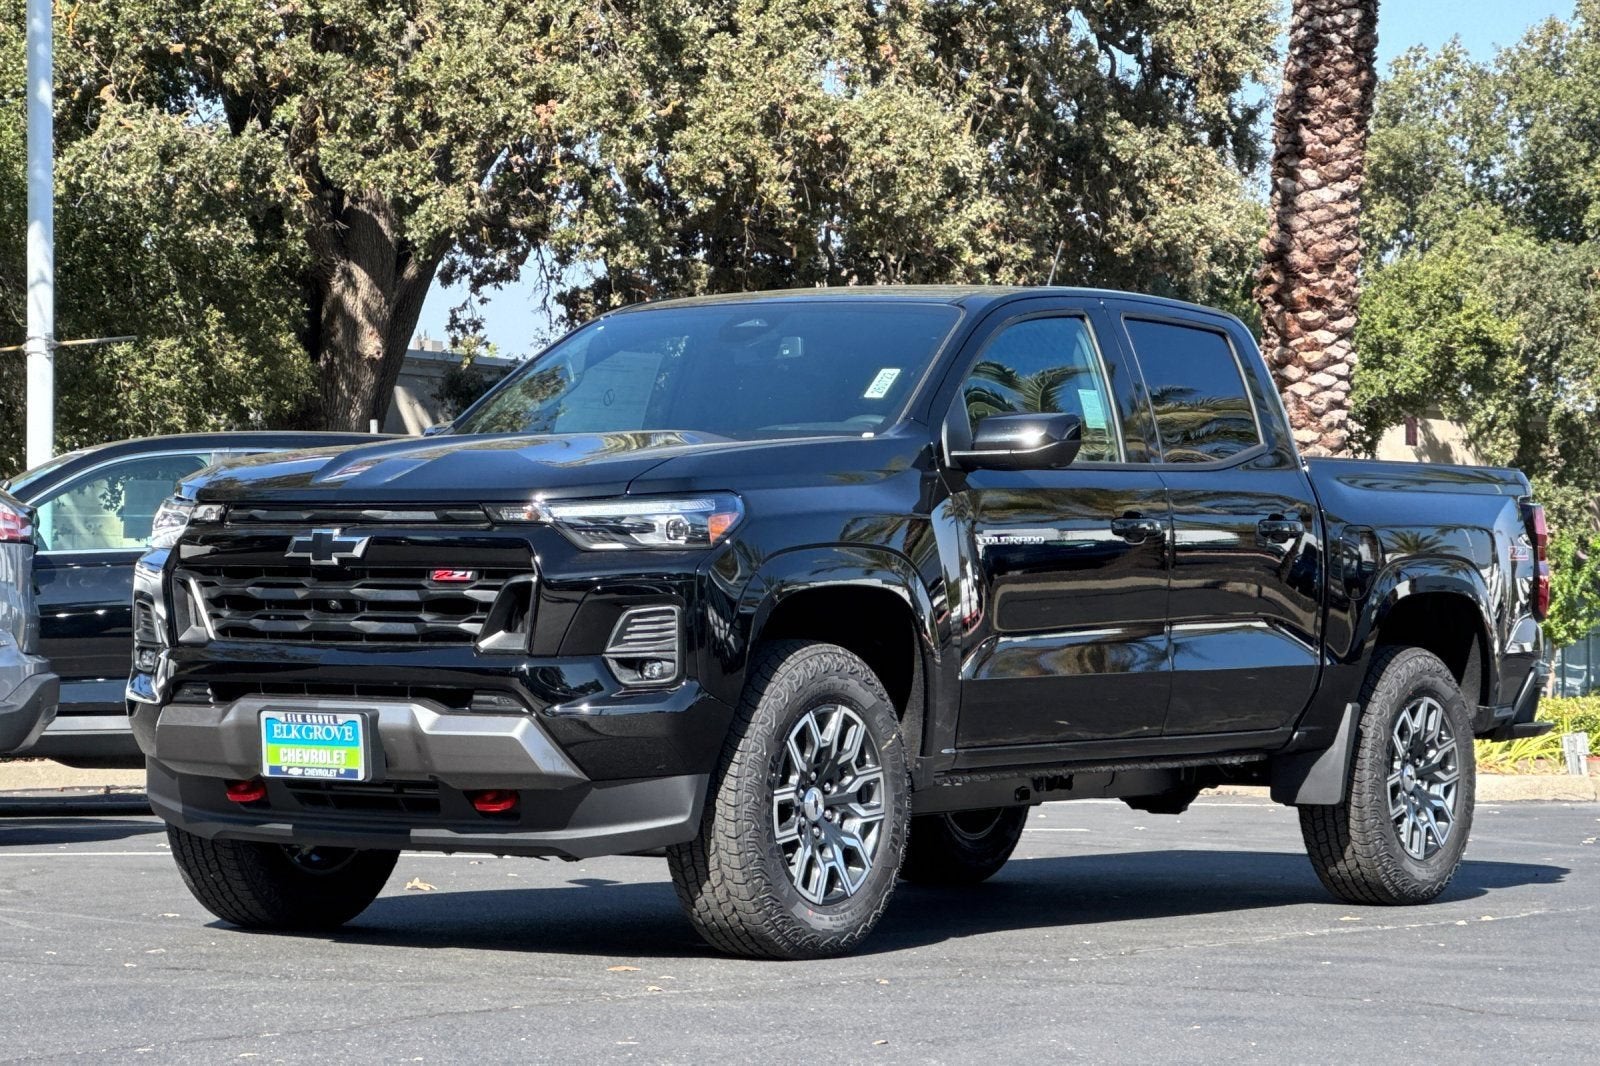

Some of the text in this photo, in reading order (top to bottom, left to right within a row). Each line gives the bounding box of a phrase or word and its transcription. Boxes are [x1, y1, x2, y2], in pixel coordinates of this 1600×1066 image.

[286, 713, 335, 724] ELK GROVE
[272, 724, 354, 741] ELK GROVE
[280, 748, 347, 765] CHEVROLET
[304, 768, 338, 777] CHEVROLET
